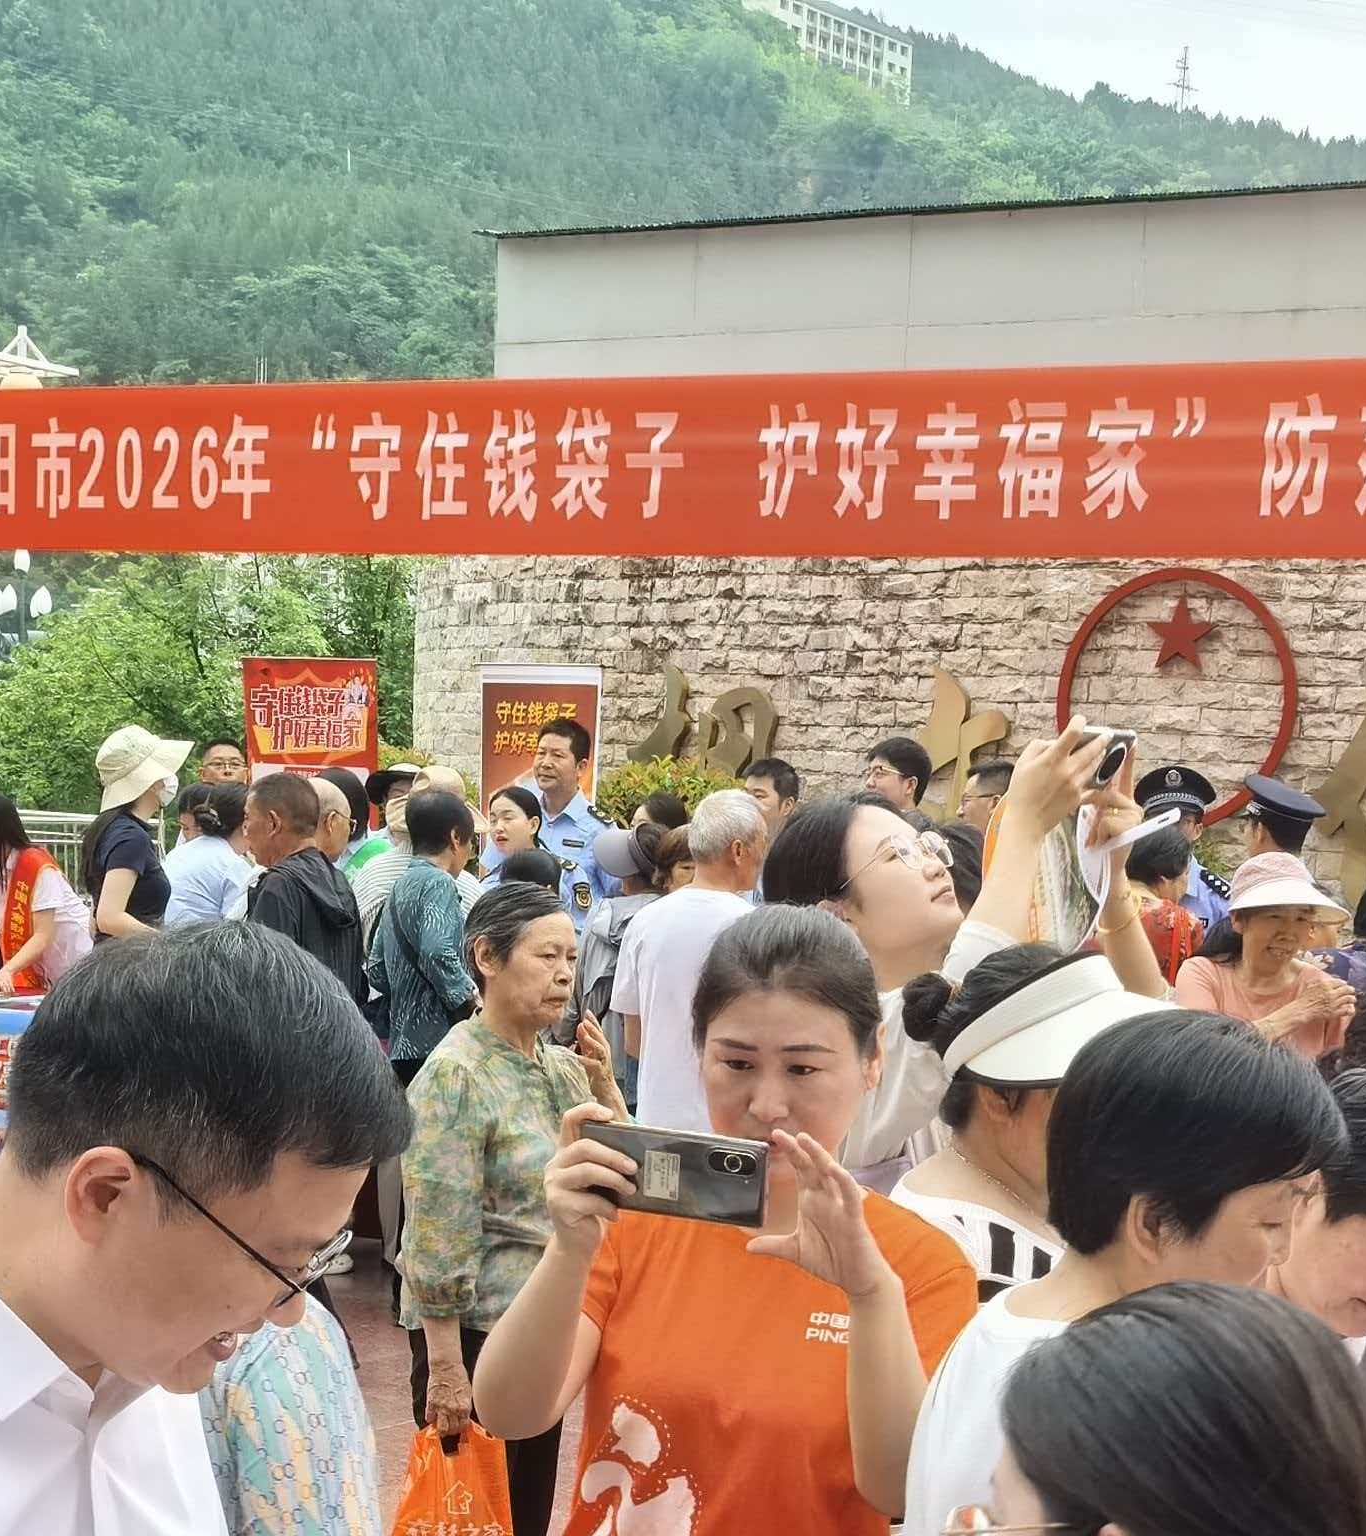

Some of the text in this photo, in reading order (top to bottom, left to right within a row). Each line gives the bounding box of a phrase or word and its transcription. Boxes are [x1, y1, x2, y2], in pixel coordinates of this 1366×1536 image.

[495, 700, 578, 726] 守住钱袋子
[810, 1312, 850, 1329] 中国
